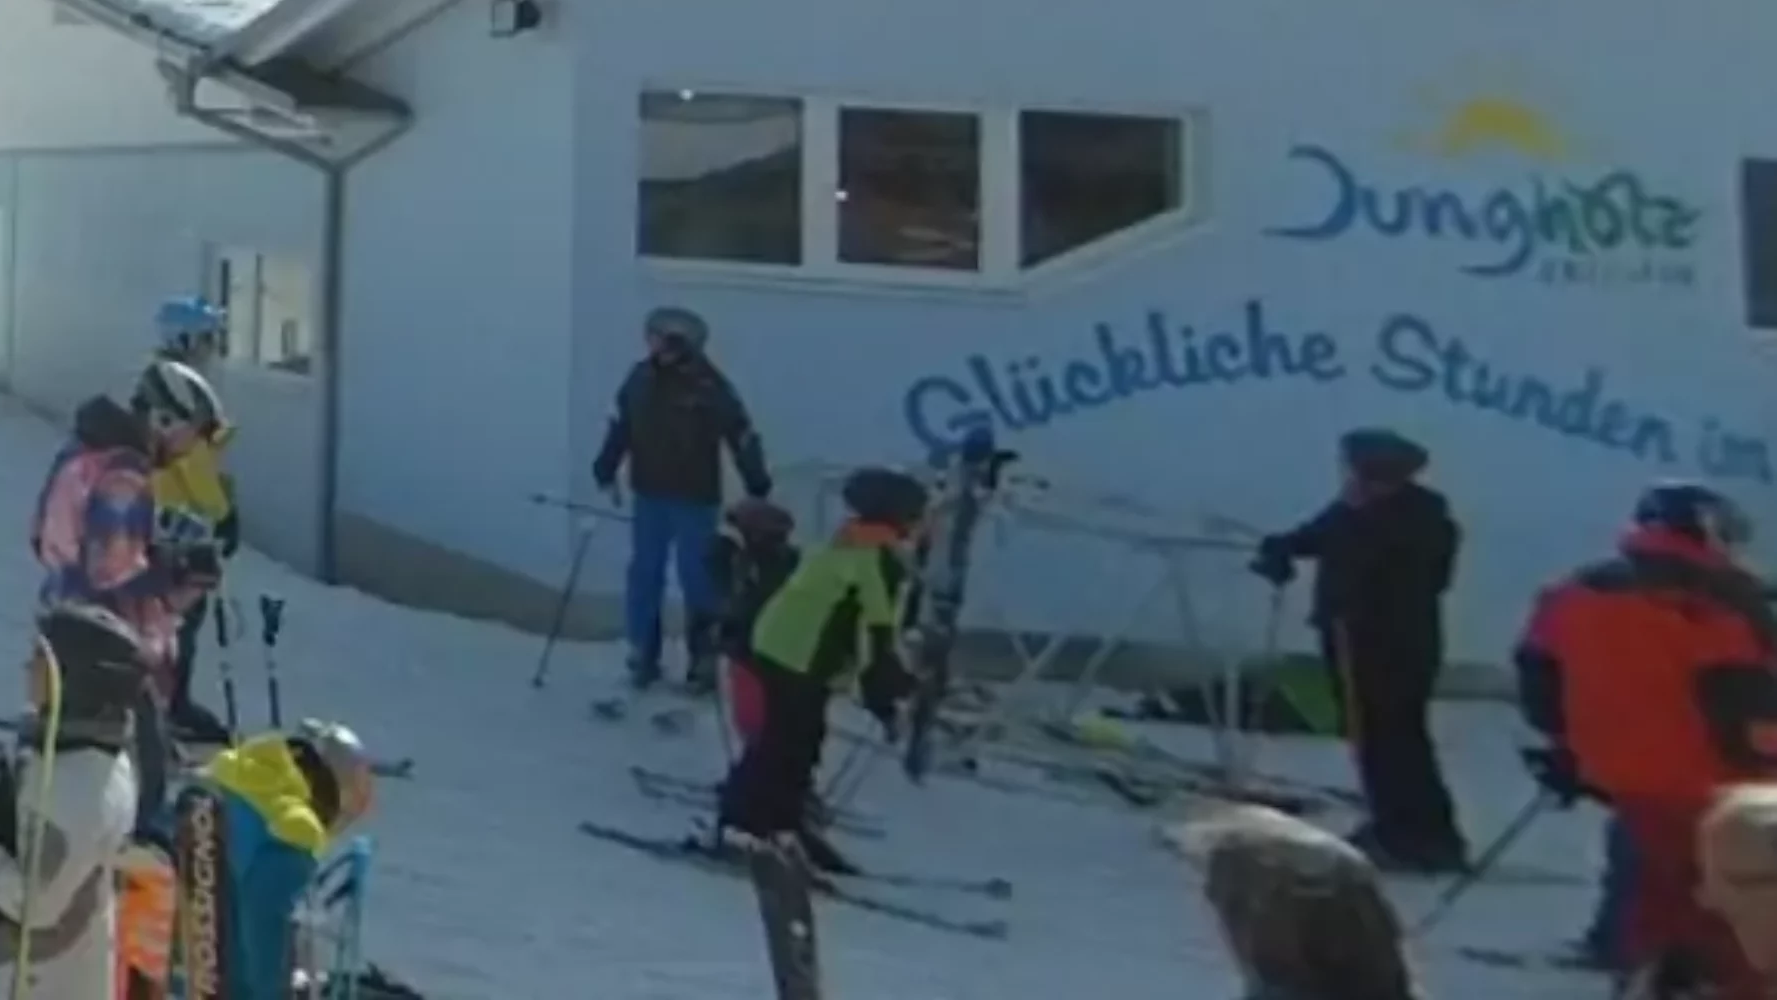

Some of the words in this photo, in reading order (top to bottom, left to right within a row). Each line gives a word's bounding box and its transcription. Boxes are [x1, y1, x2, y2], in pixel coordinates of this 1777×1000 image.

[1263, 145, 1701, 274] Jungholz
[904, 301, 1343, 467] Glückliche
[1371, 314, 1675, 463] Stunden
[1696, 414, 1774, 485] im
